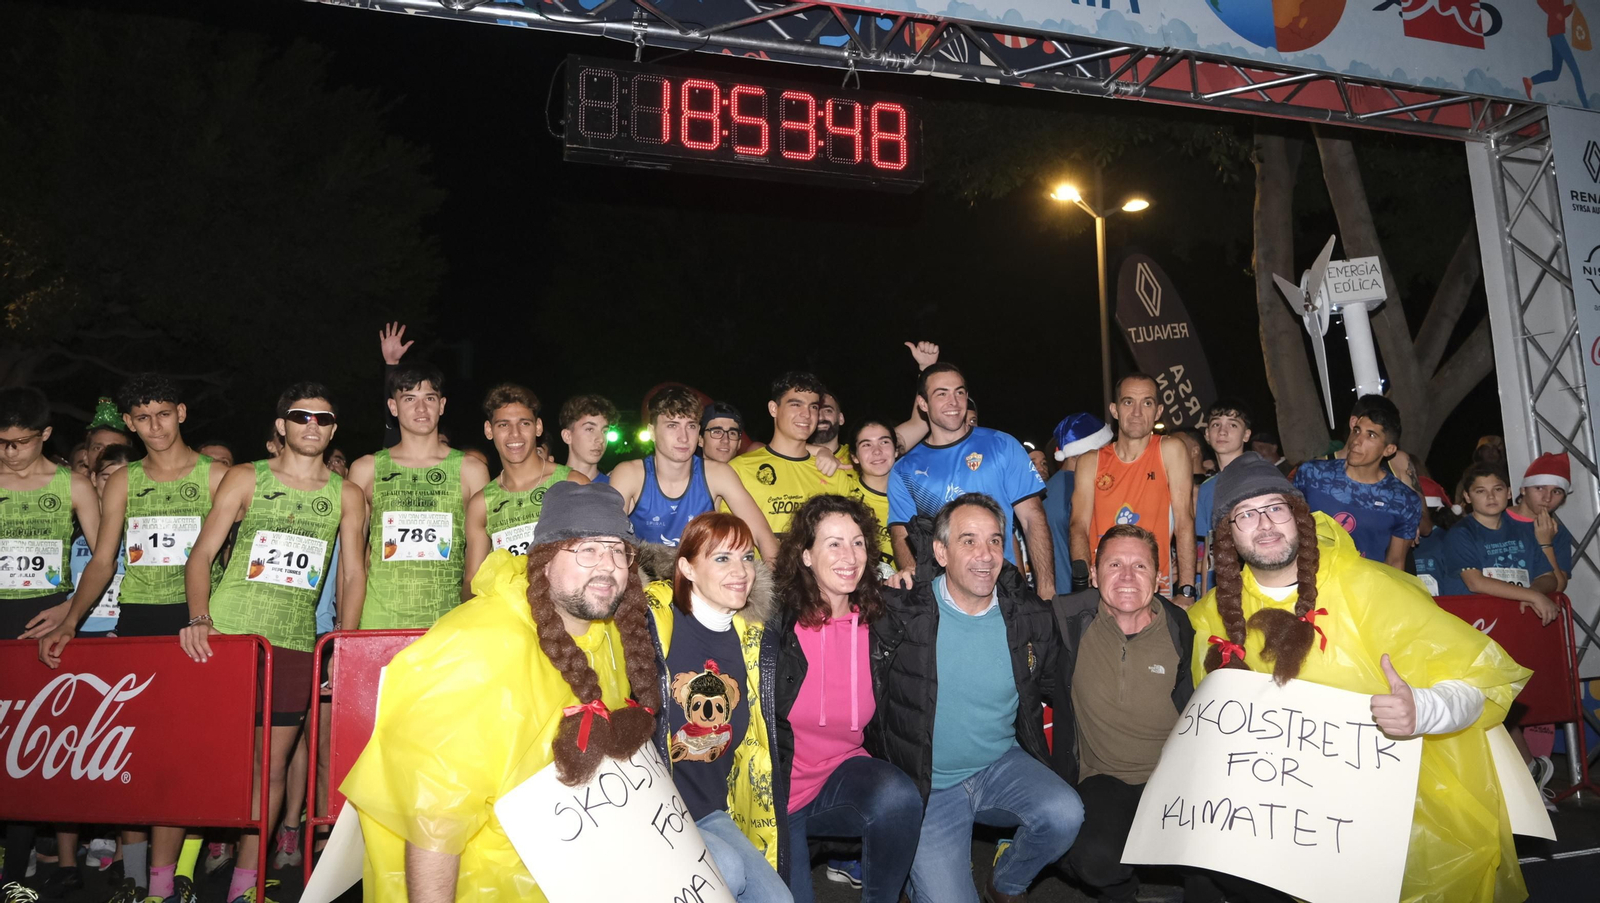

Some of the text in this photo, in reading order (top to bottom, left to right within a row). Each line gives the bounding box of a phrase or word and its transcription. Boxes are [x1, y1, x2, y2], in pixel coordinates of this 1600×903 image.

[662, 79, 907, 170] 18:53:48
[1570, 189, 1600, 204] REN
[148, 532, 176, 548] 15
[397, 528, 437, 543] 786
[0, 555, 45, 571] 209
[266, 549, 309, 569] 210
[1178, 699, 1401, 769] SKOLSTREJK
[1227, 751, 1314, 788] FÖR
[651, 795, 689, 849] FÖR
[1161, 796, 1354, 854] KLIMATET
